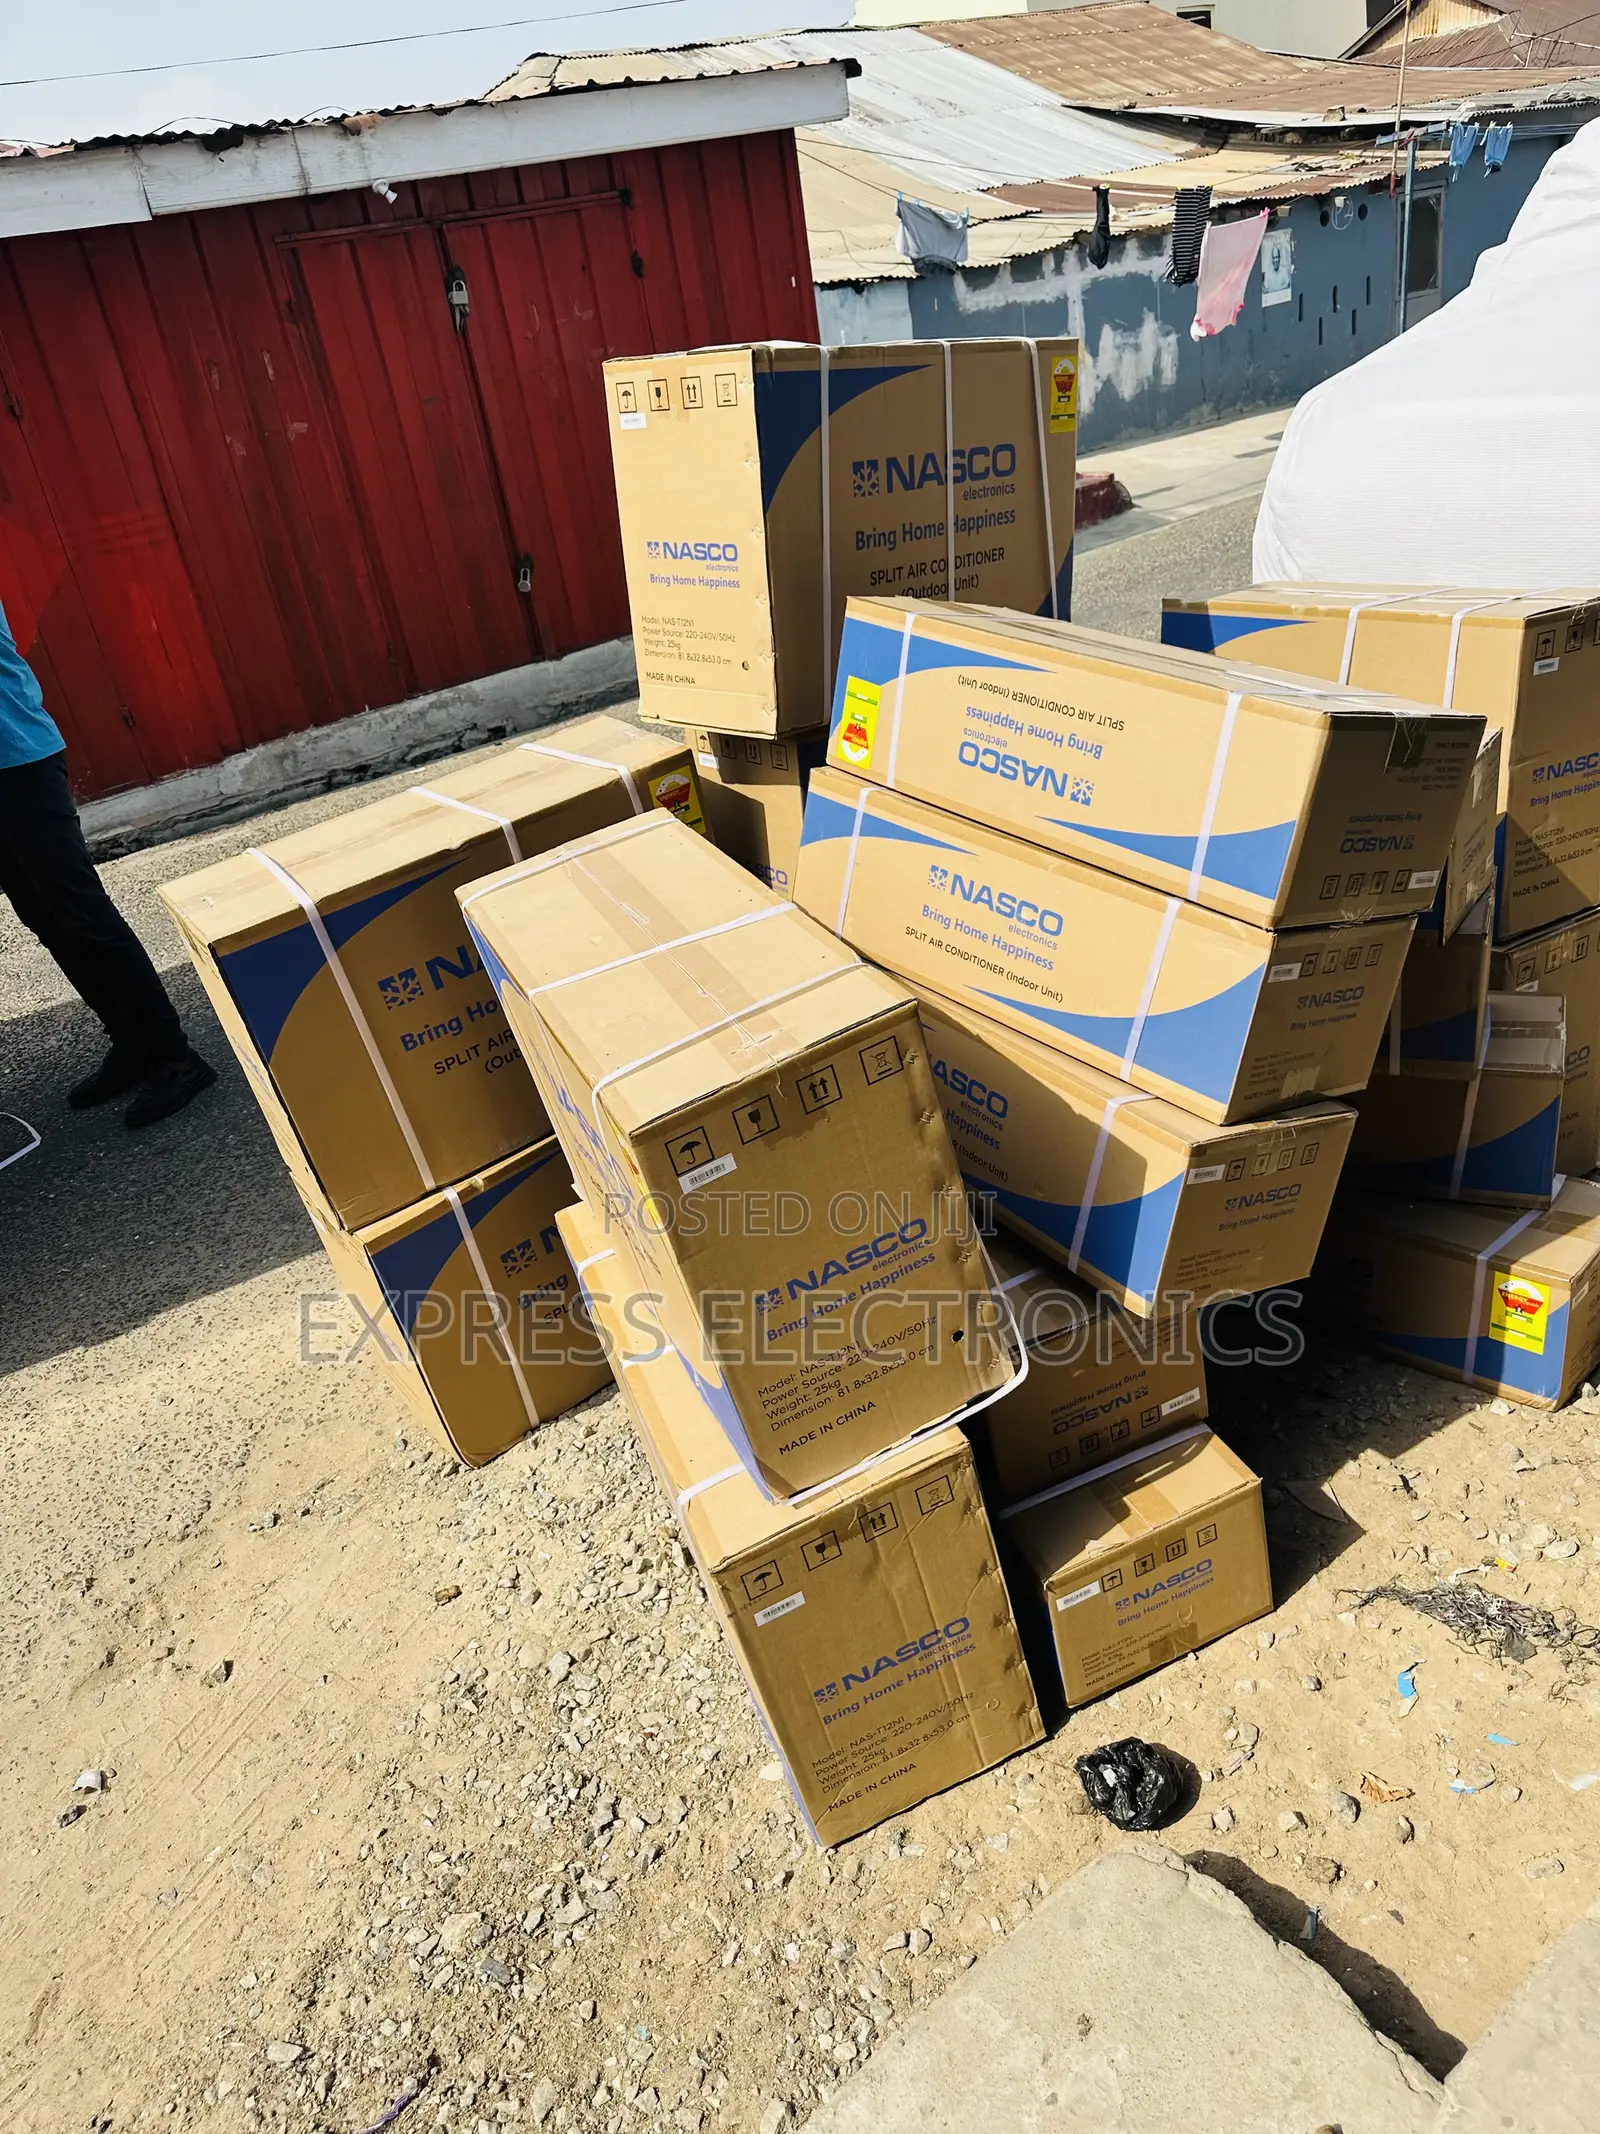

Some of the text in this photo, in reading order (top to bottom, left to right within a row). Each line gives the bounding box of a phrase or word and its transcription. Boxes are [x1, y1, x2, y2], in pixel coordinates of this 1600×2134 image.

[886, 443, 1016, 494] NASCO
[963, 481, 1015, 501] electronics
[662, 541, 738, 561] NASCO
[855, 527, 897, 551] Bring
[902, 521, 945, 543] Home
[650, 573, 740, 589] Bring Home Happiness
[706, 563, 739, 572] electronics
[870, 566, 903, 586] SPLIT
[907, 562, 927, 580] AIR
[954, 573, 979, 591] Unit)
[642, 627, 661, 636] Power
[646, 672, 696, 684] MADE IN CHINA
[957, 674, 1125, 731] SPLIT AIR CONDITIONER (Indoor Unit)
[963, 727, 1008, 748] electronics
[965, 706, 1103, 760] Bring Home Happiness
[958, 741, 1068, 798] NASCO
[1551, 788, 1573, 800] Home
[1340, 836, 1403, 854] NASCO
[950, 873, 1063, 937] NASCO
[922, 904, 1055, 971] Bring Home Happiness
[1008, 923, 1058, 951] electronics
[905, 926, 1063, 1003] SPLIT AIR CONDITIONER (Indoor Unit)
[1308, 986, 1364, 1008] NASCO
[400, 1000, 501, 1052] Bring Ho
[434, 1044, 480, 1075] SPLIT
[930, 1058, 1008, 1118] ASCO
[945, 1107, 1000, 1150] Happiness
[960, 1100, 1003, 1131] electronics
[959, 1144, 988, 1168] (Indoor
[989, 1162, 1008, 1182] Unit)
[1238, 1183, 1302, 1209] NASCO
[786, 1218, 927, 1301] NASCO
[872, 1238, 931, 1271] electronics
[517, 1274, 568, 1310] Bring
[767, 1252, 936, 1341] Bring Home Happiness
[758, 1340, 861, 1397] Model: NAS-T12N1
[762, 1316, 937, 1409] Power Source: 220-240V/50Hz
[766, 1378, 841, 1420] Weight: 25kg
[770, 1394, 835, 1432] Dimension:
[918, 1344, 935, 1357] cm
[779, 1401, 876, 1455] MADE IN CHINA
[1053, 1391, 1132, 1435] NASCO
[1117, 1576, 1215, 1627] Bring Home Happiness
[1133, 1558, 1212, 1604] NASCO
[842, 1616, 970, 1691] NASCO
[918, 1633, 972, 1662] electronics
[822, 1643, 976, 1725] Bring Home Happiness
[1086, 1675, 1105, 1687] MADE
[1114, 1661, 1135, 1673] CHINA
[812, 1716, 905, 1768] Model: NAS-T12N1
[815, 1691, 975, 1777] Power Source: 220-240V/50Hz
[822, 1761, 879, 1794] Dimension:
[956, 1713, 971, 1725] cm
[861, 1747, 886, 1765] 25kg
[828, 1762, 917, 1812] MADE IN CHINA
